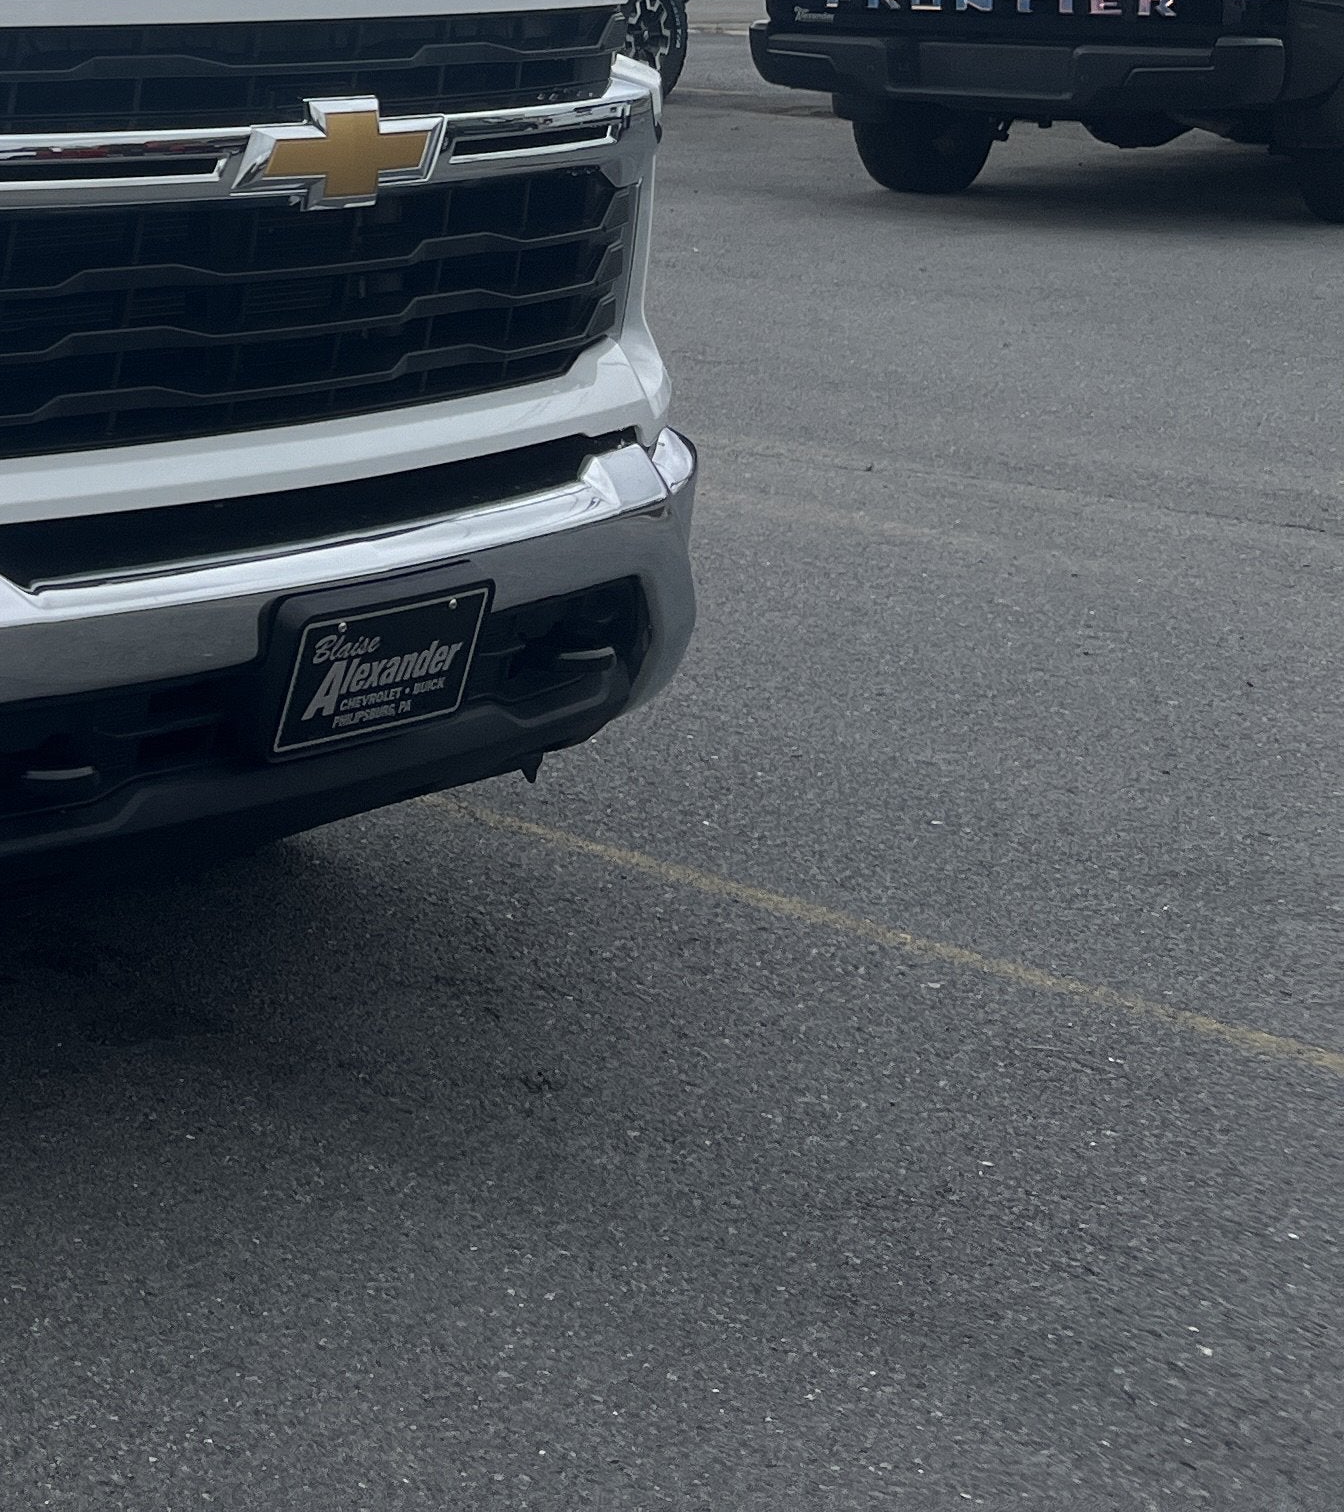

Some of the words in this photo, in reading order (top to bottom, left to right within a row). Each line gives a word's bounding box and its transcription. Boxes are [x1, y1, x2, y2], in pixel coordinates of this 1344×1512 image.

[313, 634, 381, 664] Blaise
[301, 639, 463, 721] Alexander
[339, 686, 403, 711] CHEVROLET
